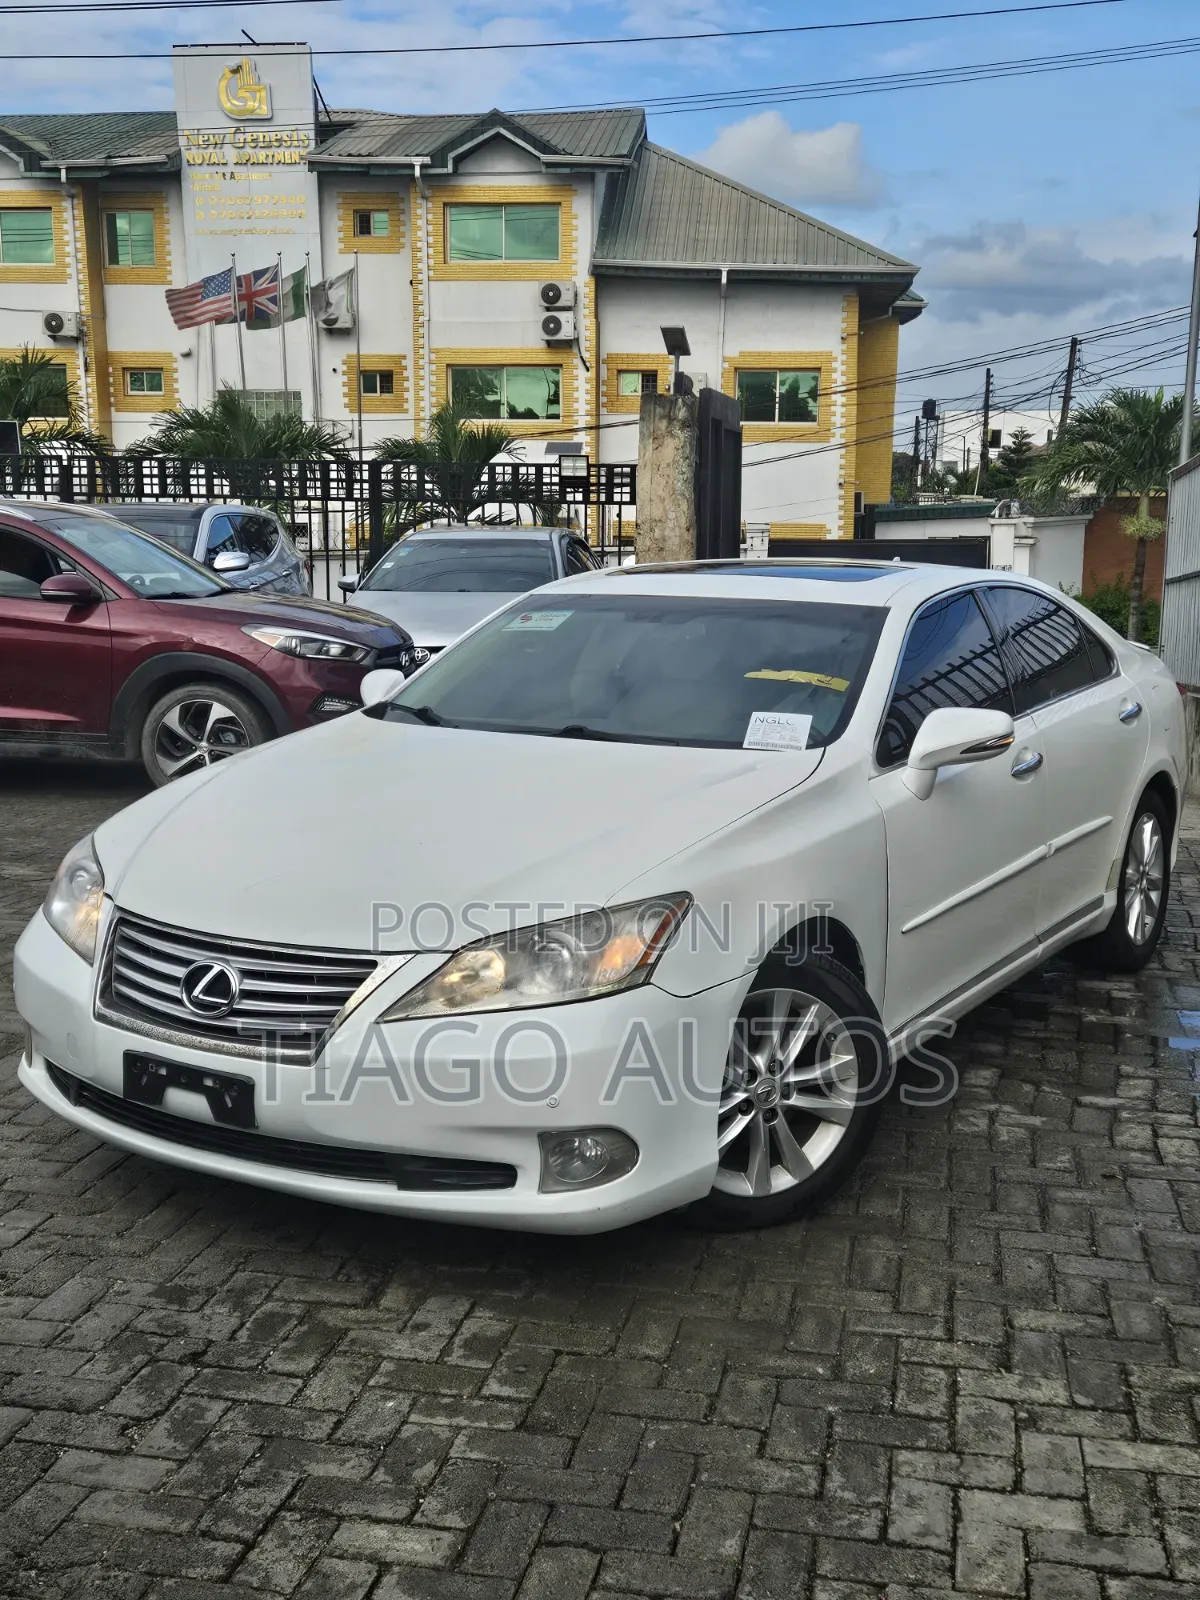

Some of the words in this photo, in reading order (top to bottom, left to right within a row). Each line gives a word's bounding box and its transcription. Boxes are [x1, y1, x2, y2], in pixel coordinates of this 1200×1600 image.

[183, 129, 225, 149] New
[229, 127, 309, 149] Genesis
[186, 151, 228, 165] ROYAL
